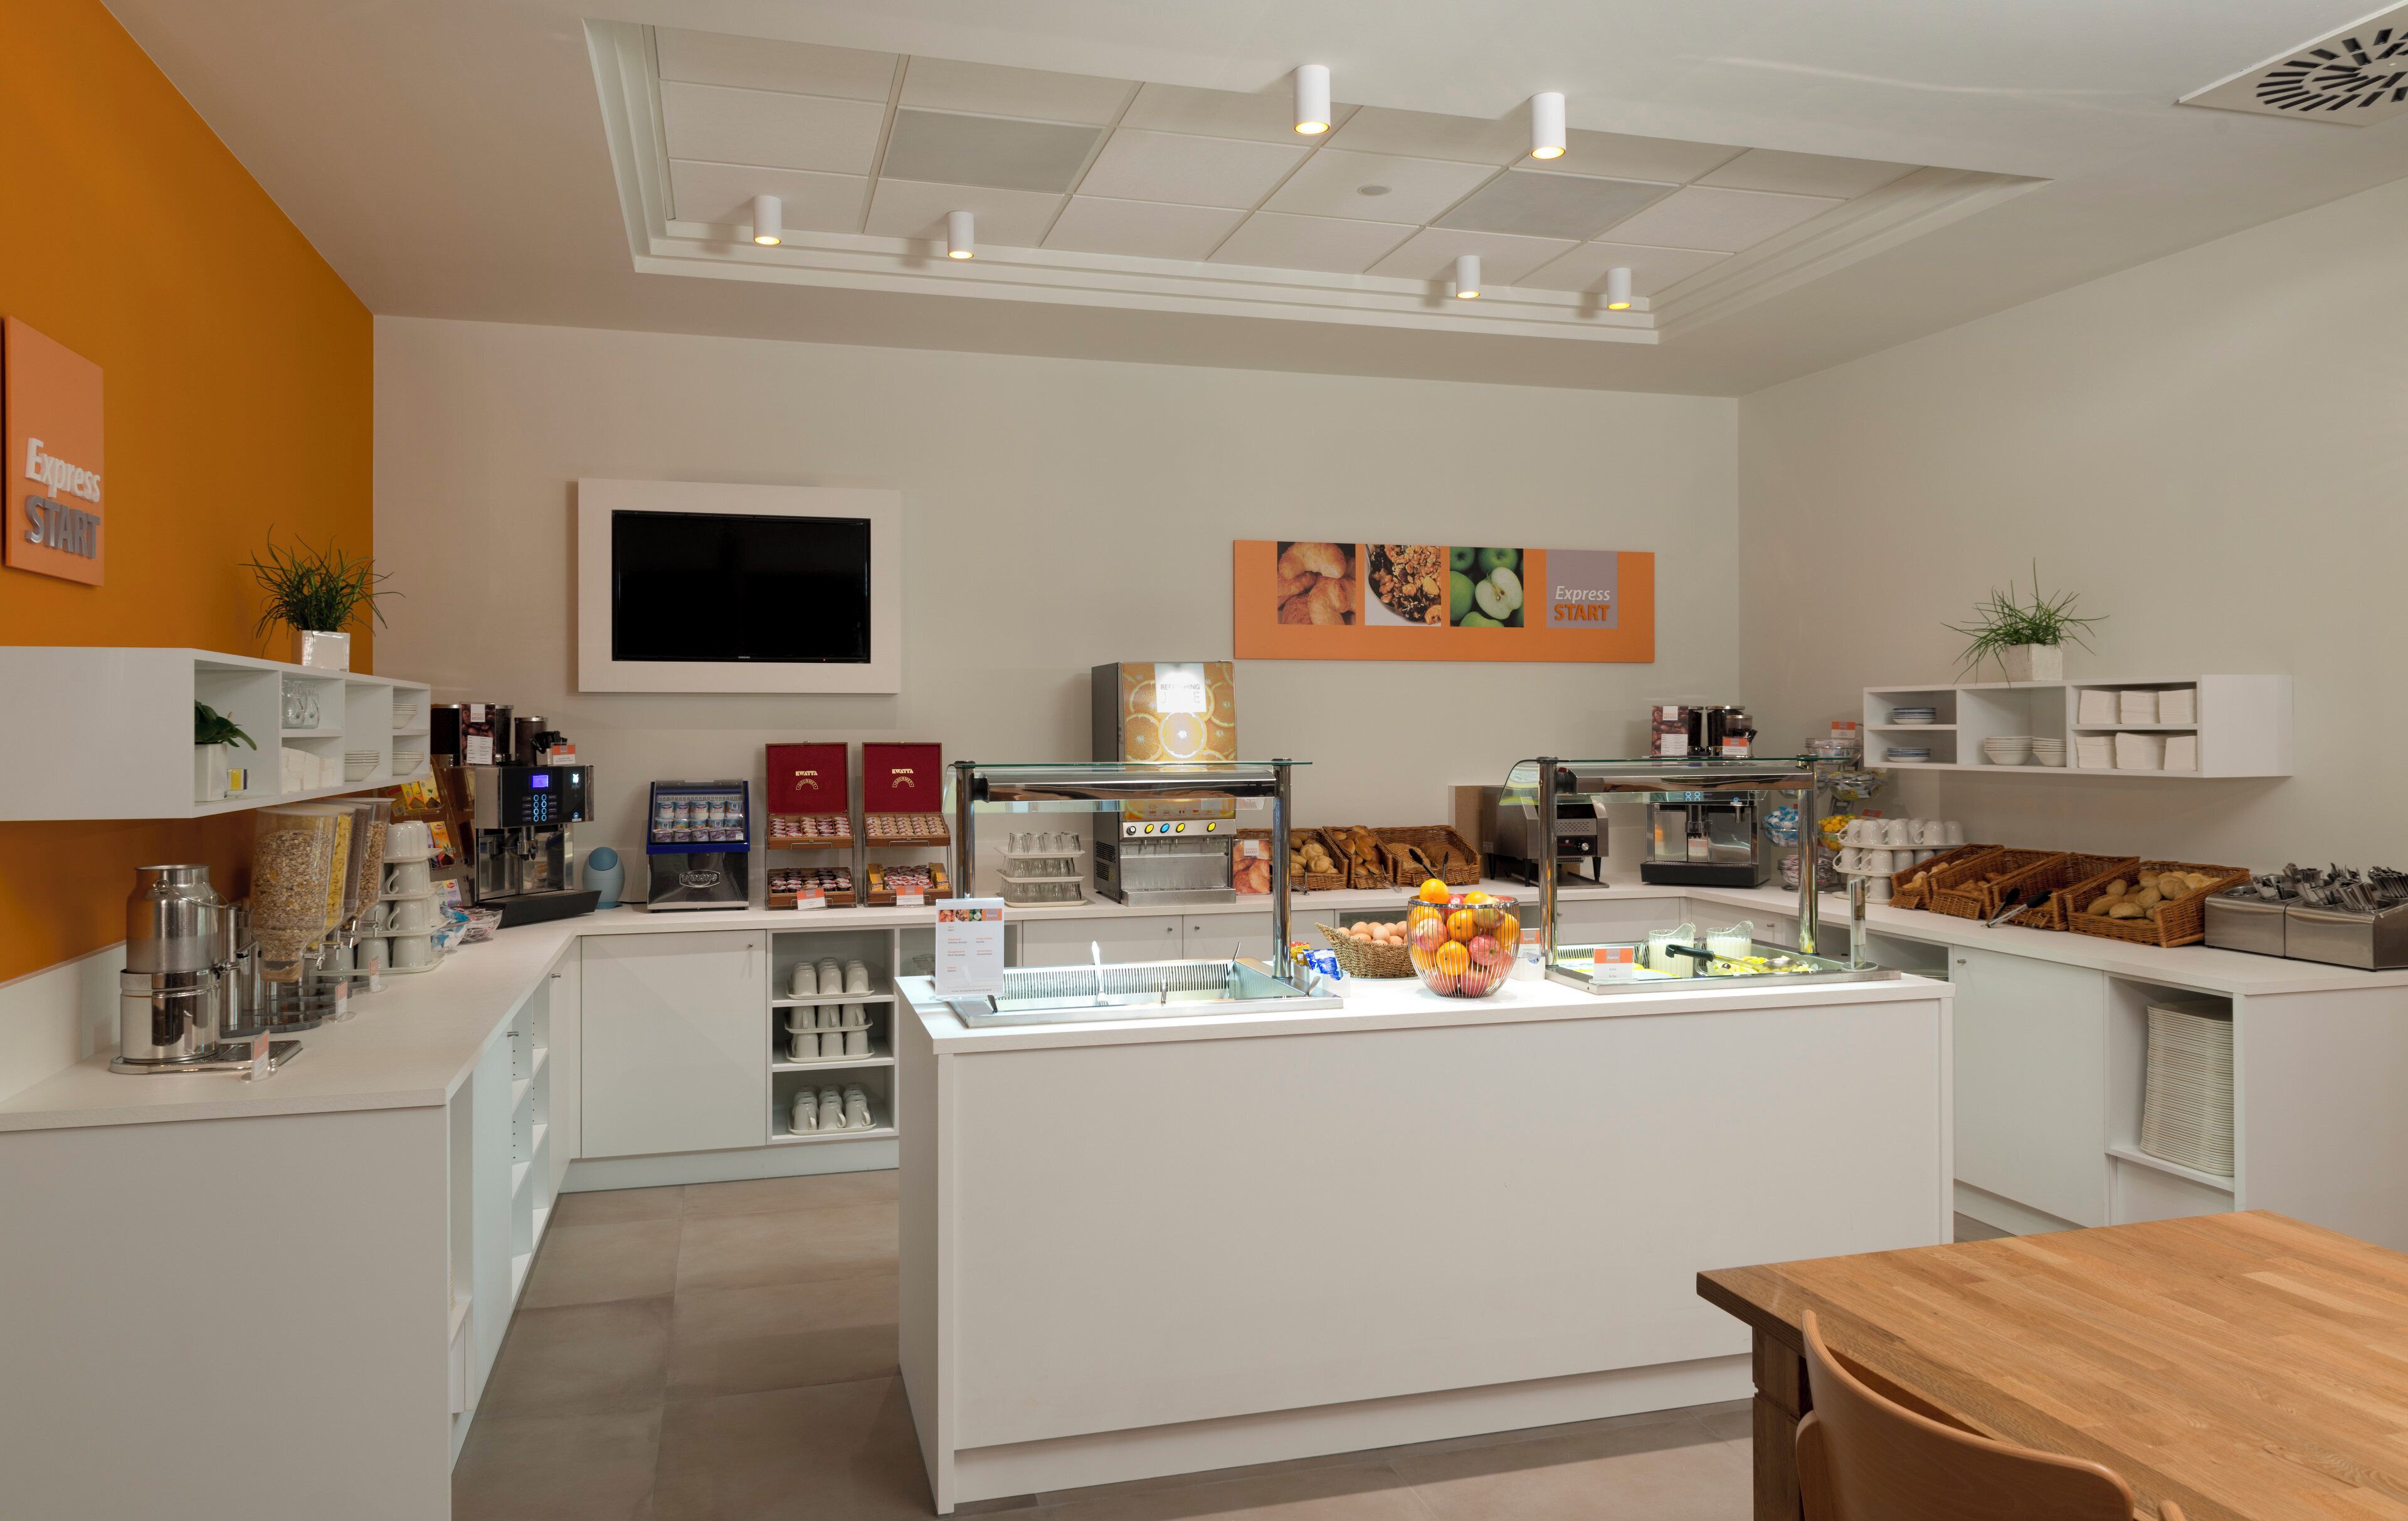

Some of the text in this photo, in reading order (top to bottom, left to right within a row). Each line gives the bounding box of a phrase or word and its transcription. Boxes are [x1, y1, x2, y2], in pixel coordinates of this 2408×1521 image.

[25, 437, 100, 502] Express
[24, 494, 100, 559] START
[1555, 586, 1610, 603] Express
[1555, 604, 1610, 621] START
